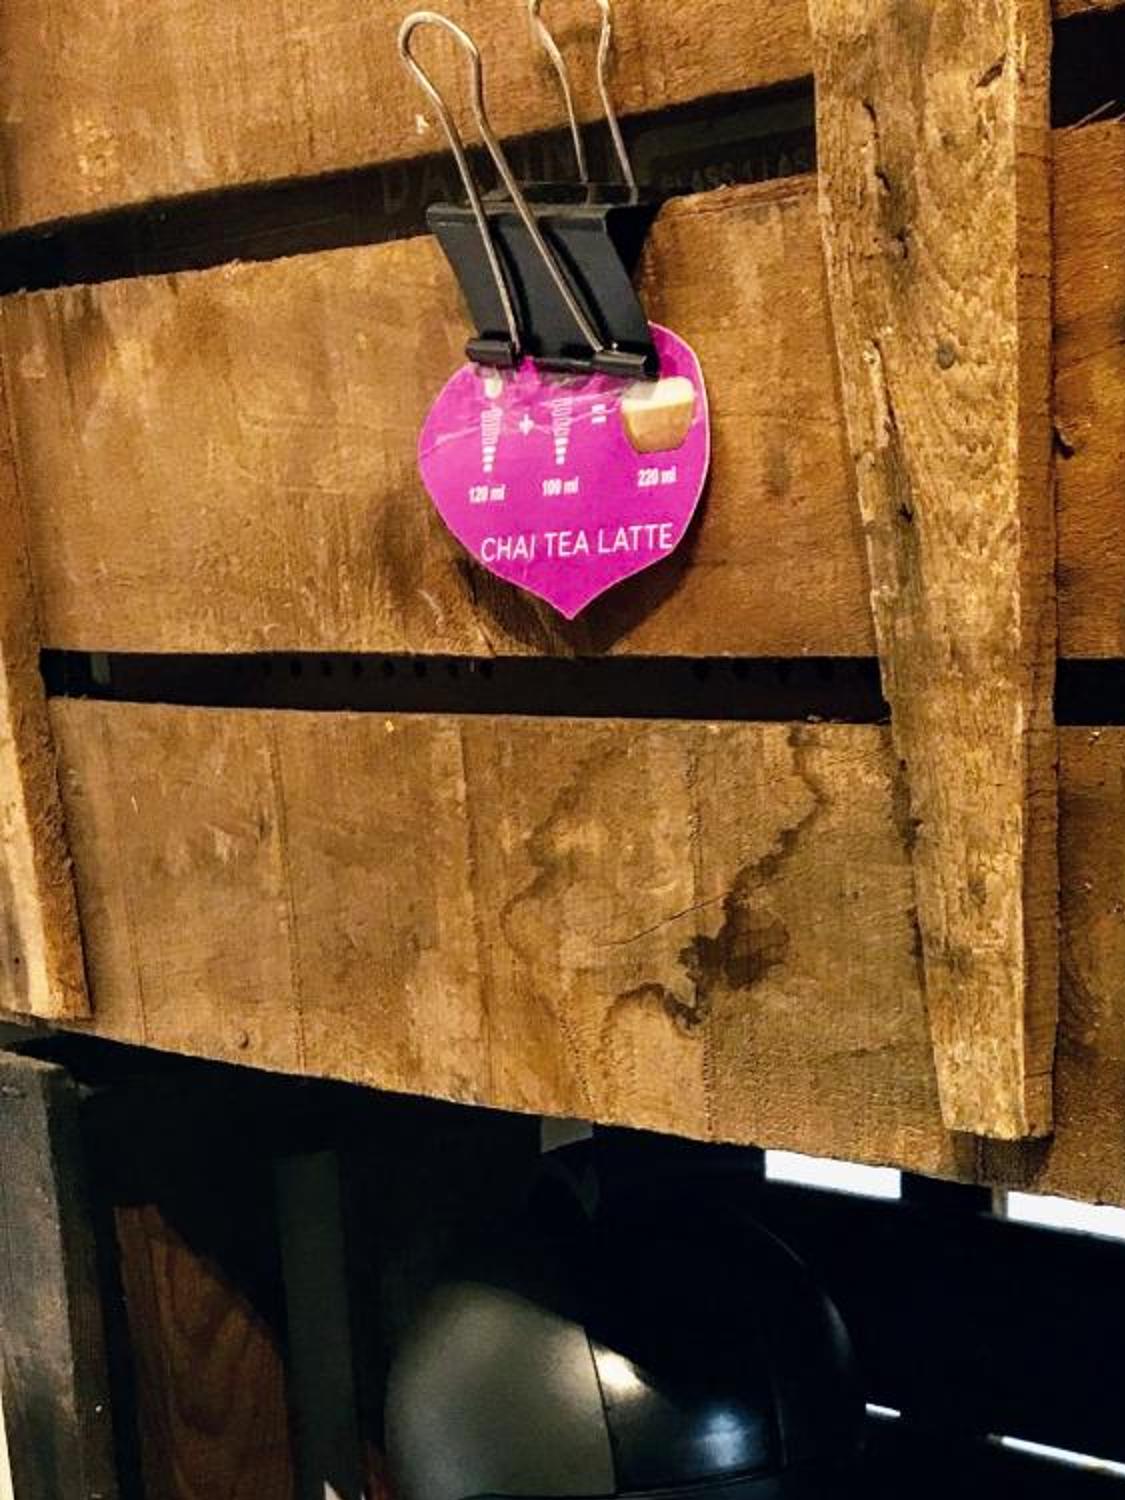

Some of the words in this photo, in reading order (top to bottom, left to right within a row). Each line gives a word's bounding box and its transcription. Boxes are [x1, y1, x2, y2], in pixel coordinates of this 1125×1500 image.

[481, 534, 535, 562] CHAI
[545, 530, 589, 557] TEA
[598, 523, 673, 554] LATTE
